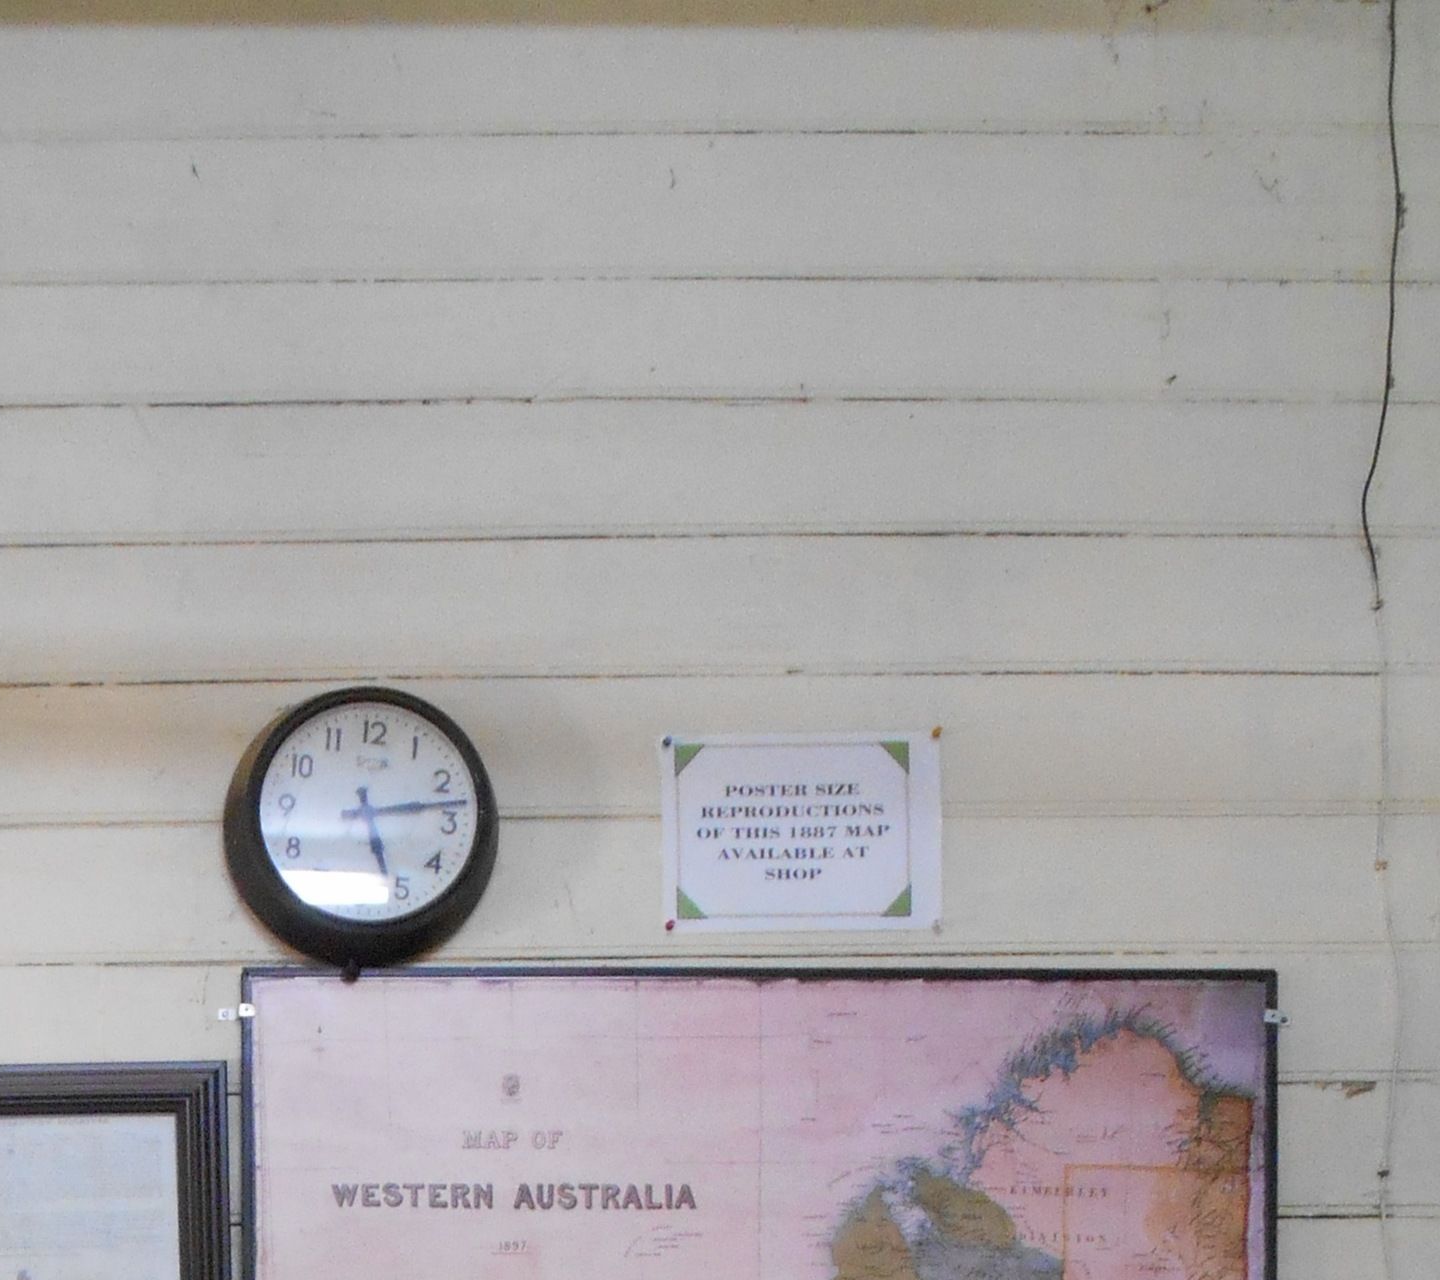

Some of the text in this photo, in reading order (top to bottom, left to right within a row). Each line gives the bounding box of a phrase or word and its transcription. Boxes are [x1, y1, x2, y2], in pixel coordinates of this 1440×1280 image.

[325, 727, 342, 751] 11
[363, 719, 388, 745] 12
[411, 736, 419, 760] 1
[291, 753, 313, 778] 10
[433, 769, 451, 793] 2
[725, 782, 861, 798] POSTER SIZE
[278, 793, 296, 817] 9
[700, 803, 885, 819] REPRODUCTIONS
[440, 810, 457, 834] 3
[696, 824, 891, 840] OF THIS 1887 MAP
[285, 836, 301, 859] 8
[717, 846, 870, 861] AVAILABLE AT
[423, 850, 442, 875] 4
[764, 867, 823, 881] SHOP
[394, 877, 410, 900] 5
[461, 1129, 564, 1150] MAP OF
[331, 1182, 698, 1211] WESTERN AUSTRALIA
